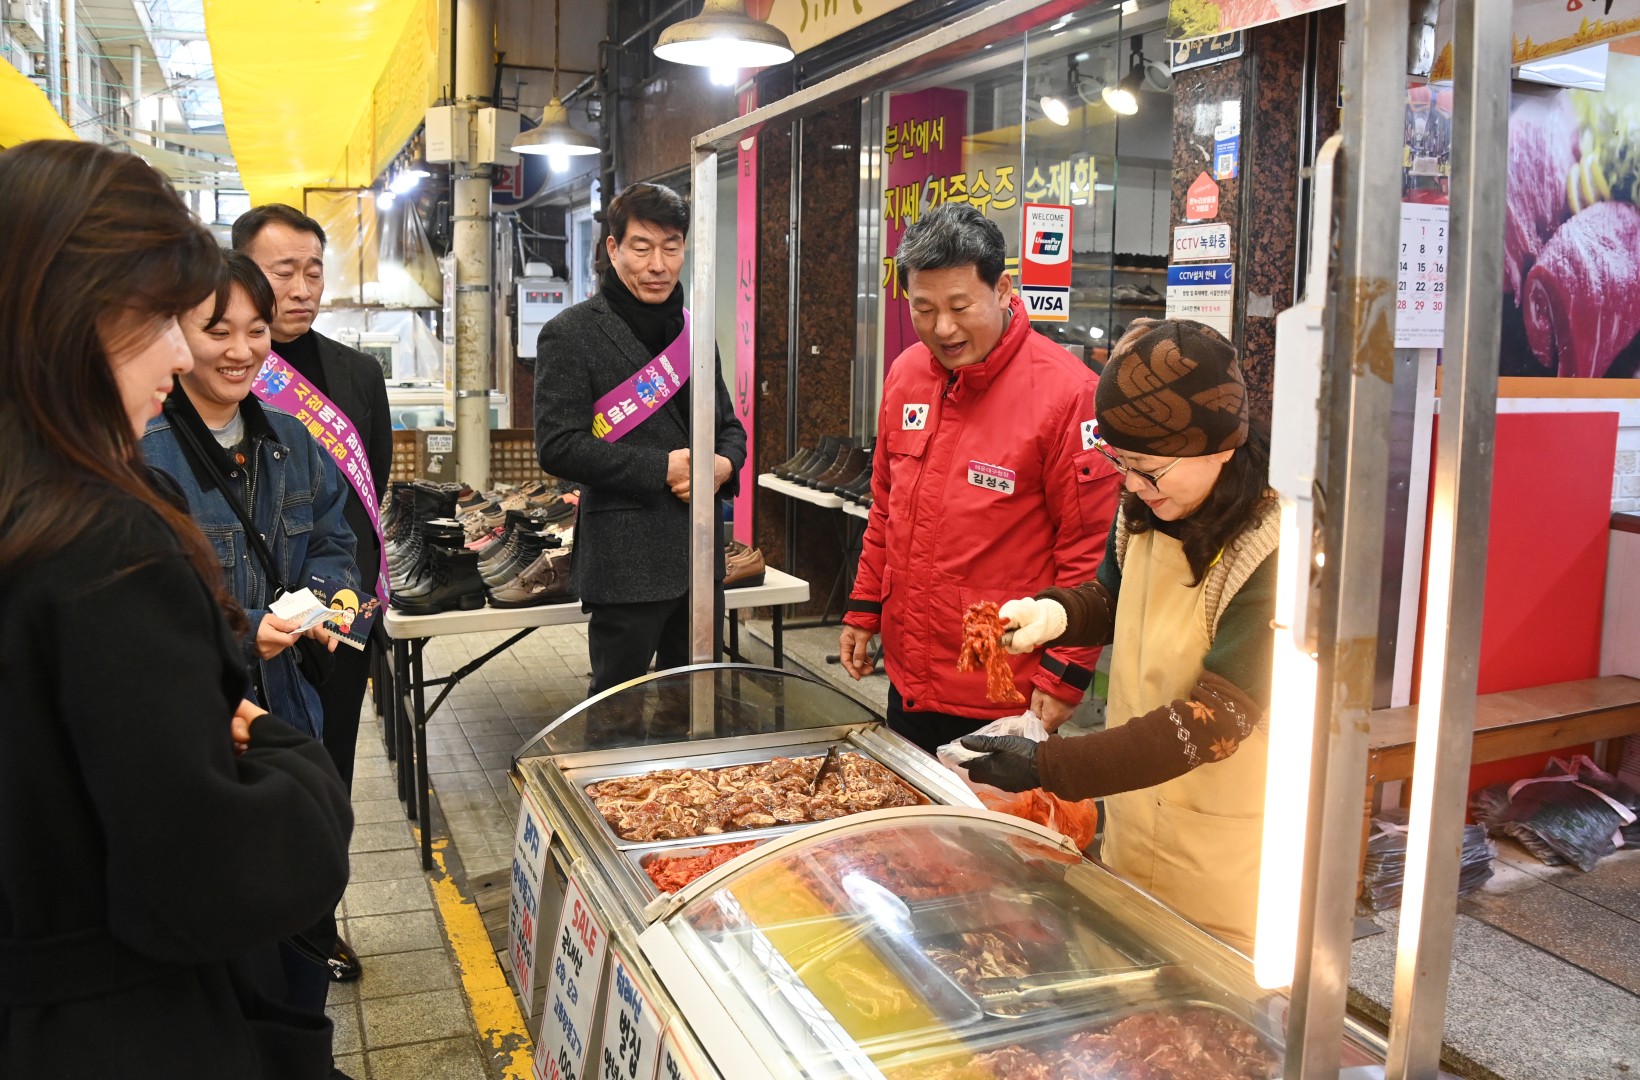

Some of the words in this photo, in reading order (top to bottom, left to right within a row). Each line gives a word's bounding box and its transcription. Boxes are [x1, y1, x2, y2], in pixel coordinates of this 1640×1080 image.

[884, 116, 945, 163] 부산에서
[1024, 156, 1099, 207] 수제화
[1032, 212, 1064, 222] WELCOME
[1421, 226, 1425, 236] 1
[1438, 227, 1444, 237] 2
[1401, 243, 1407, 253] 7
[1419, 244, 1426, 254] 8
[1437, 245, 1444, 255] 9
[1399, 262, 1408, 271] 14
[1417, 262, 1426, 272] 15
[1435, 263, 1444, 273] 16
[1398, 281, 1407, 291] 21
[1415, 282, 1426, 292] 22
[1433, 282, 1444, 292] 23
[1028, 295, 1064, 311] VISA
[1397, 300, 1407, 310] 28
[1414, 301, 1425, 311] 29
[1432, 301, 1443, 311] 30
[645, 365, 671, 398] 2025
[293, 382, 349, 435] 시장에서
[607, 398, 639, 425] 새해
[295, 408, 348, 460] 전통시장
[973, 473, 1011, 491] 김성수
[571, 899, 598, 957] SALE
[561, 925, 584, 978] 국내산
[566, 977, 579, 1007] 오리
[616, 962, 643, 1024] 칠레산
[552, 993, 583, 1060] 고추장불고기
[619, 1008, 642, 1079] 벌집
